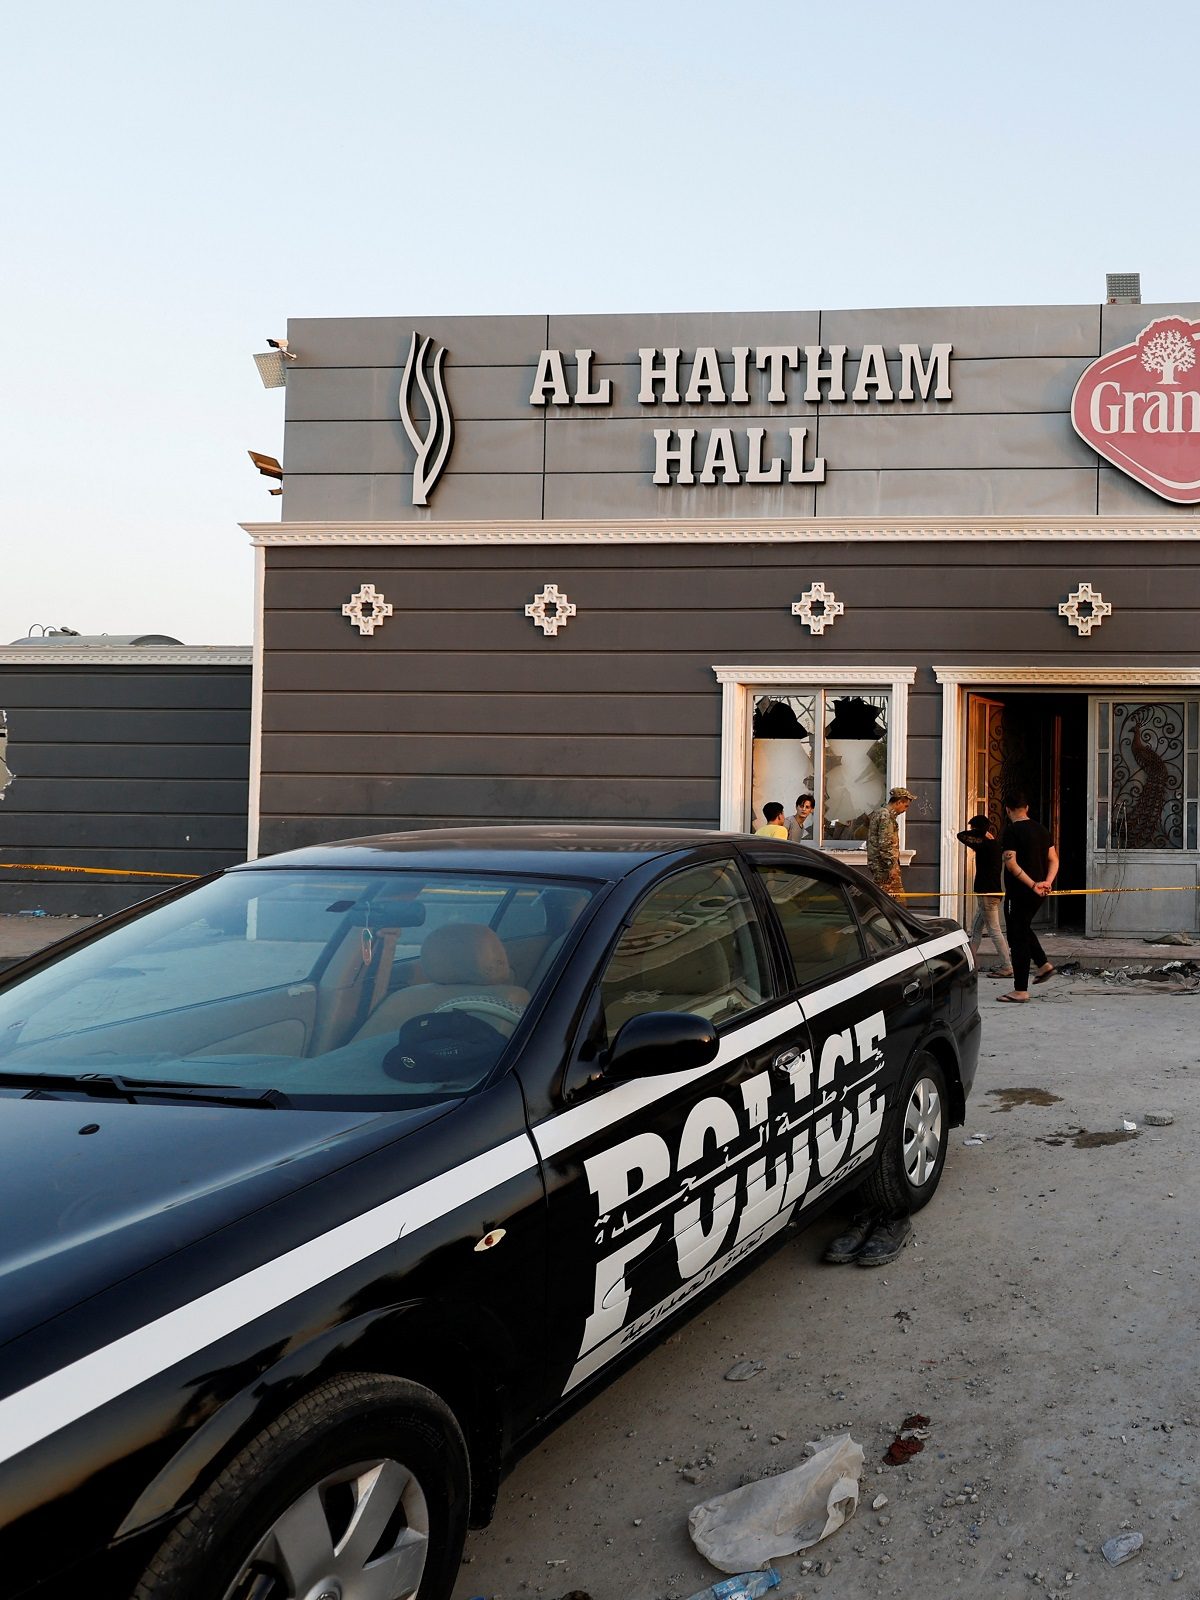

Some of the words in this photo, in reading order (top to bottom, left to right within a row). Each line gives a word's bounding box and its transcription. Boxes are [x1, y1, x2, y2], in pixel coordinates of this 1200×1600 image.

[529, 349, 613, 406] AL
[637, 343, 953, 405] HAITHAM
[652, 427, 827, 485] HALL
[774, 1050, 885, 1137] شرطة
[577, 1010, 888, 1360] POLICE
[594, 1121, 770, 1245] النجدة
